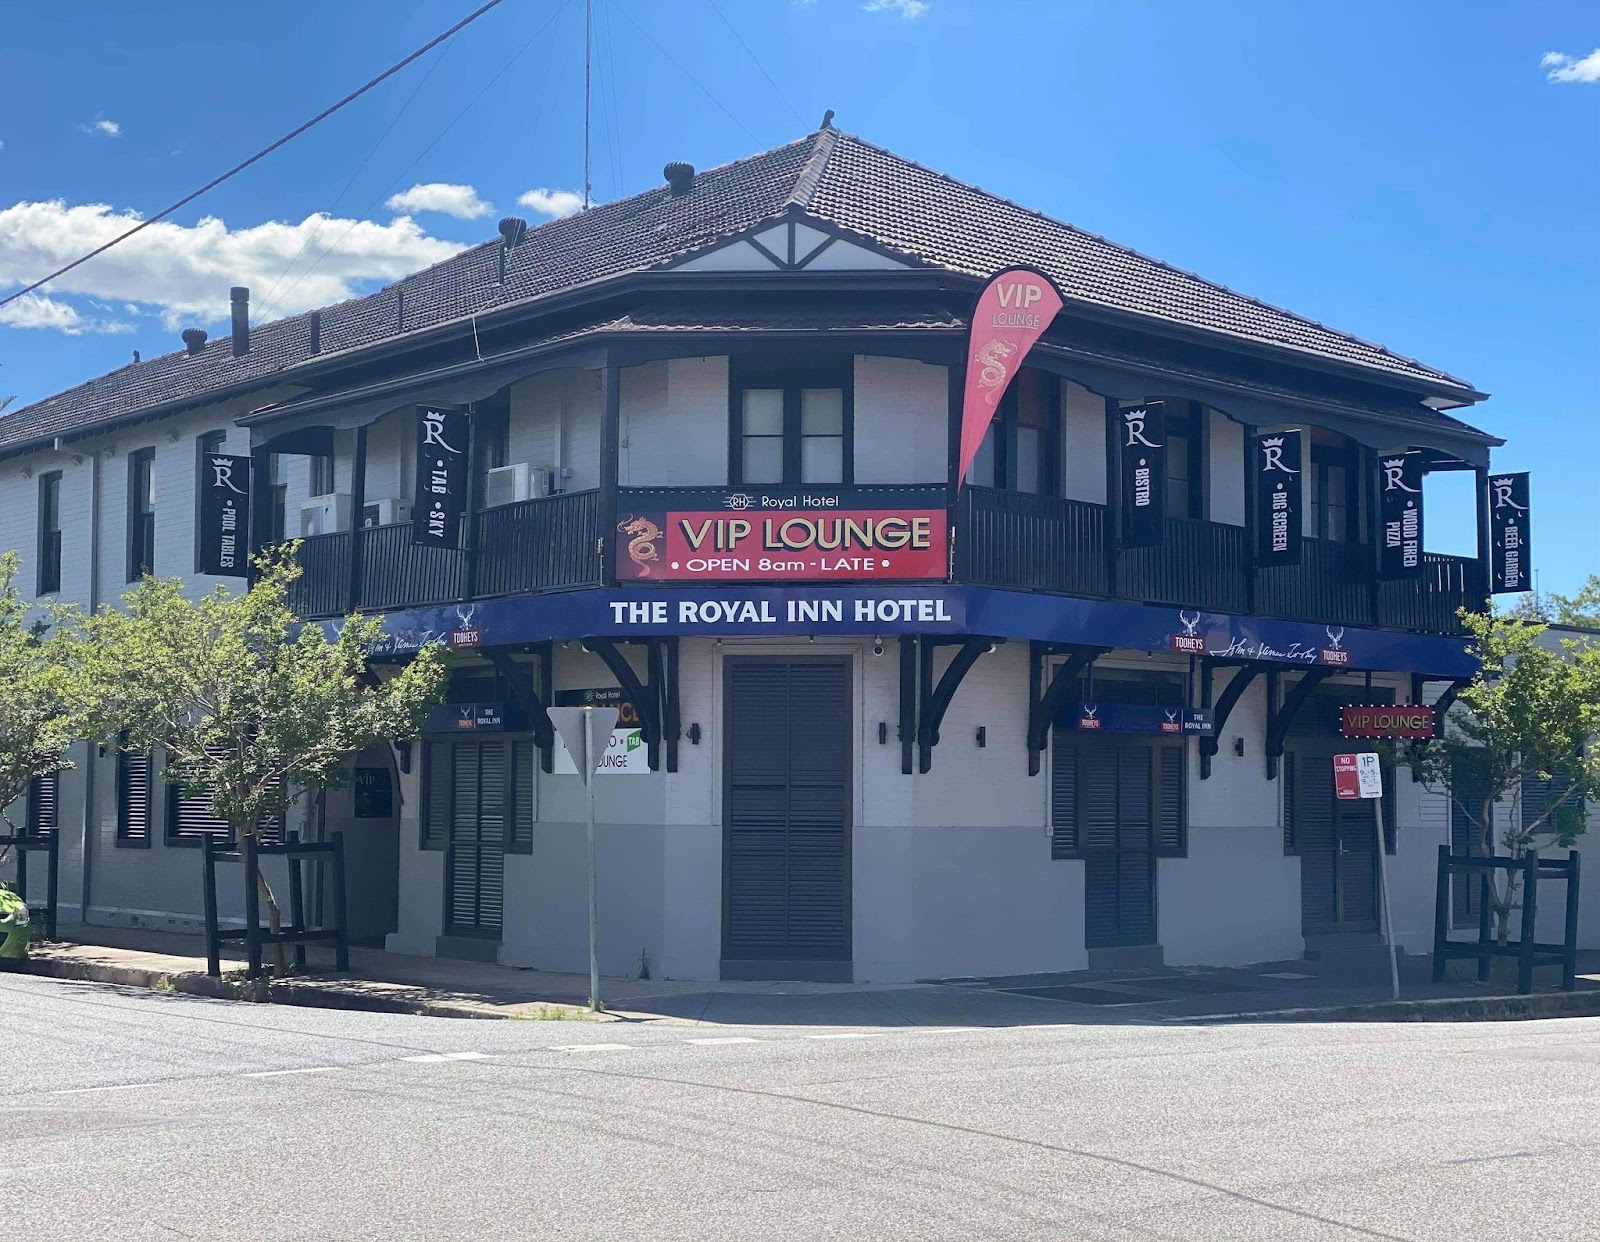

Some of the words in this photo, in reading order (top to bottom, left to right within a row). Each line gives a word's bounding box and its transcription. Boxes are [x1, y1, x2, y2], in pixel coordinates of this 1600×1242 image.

[997, 283, 1042, 308] VIP
[992, 312, 1040, 327] LOUNGE
[422, 420, 462, 454] R
[1125, 420, 1163, 448] R
[1262, 446, 1300, 473] R
[212, 466, 248, 494] R
[431, 469, 447, 494] TAB
[1135, 467, 1150, 507] BISTRO
[1384, 467, 1421, 493] R
[761, 495, 797, 509] Royal
[802, 495, 839, 507] Hotel
[1272, 492, 1287, 510] BIG
[1494, 486, 1529, 510] R
[222, 507, 236, 532] POOL
[428, 510, 445, 538] SKY
[1272, 511, 1288, 552] SCREEN
[1402, 508, 1418, 538] WOOD
[679, 518, 752, 551] VIP
[764, 517, 931, 551] LOUNGE
[1386, 521, 1401, 548] PIZZA
[1504, 526, 1518, 550] BEER
[220, 534, 235, 568] TABLES
[1403, 539, 1418, 567] FIRED
[686, 558, 750, 572] OPEN
[758, 558, 805, 571] 8am
[821, 557, 875, 571] LATE
[1504, 550, 1519, 588] GARDEN
[610, 601, 668, 624] THE
[678, 601, 776, 623] ROYAL
[787, 600, 843, 622] INN
[854, 599, 952, 622] HOTEL
[453, 631, 478, 644] TOOHEYS
[1175, 636, 1204, 650] TOOHEYS
[1323, 650, 1348, 663] TOOHEYS
[1184, 721, 1201, 730] ROYAL
[1201, 722, 1212, 730] INN
[1193, 713, 1203, 721] THE
[1347, 715, 1370, 729] VIP
[1374, 715, 1429, 729] LOUNGE
[627, 736, 640, 746] TAB
[598, 755, 628, 768] UNGE
[1362, 756, 1374, 767] 1P
